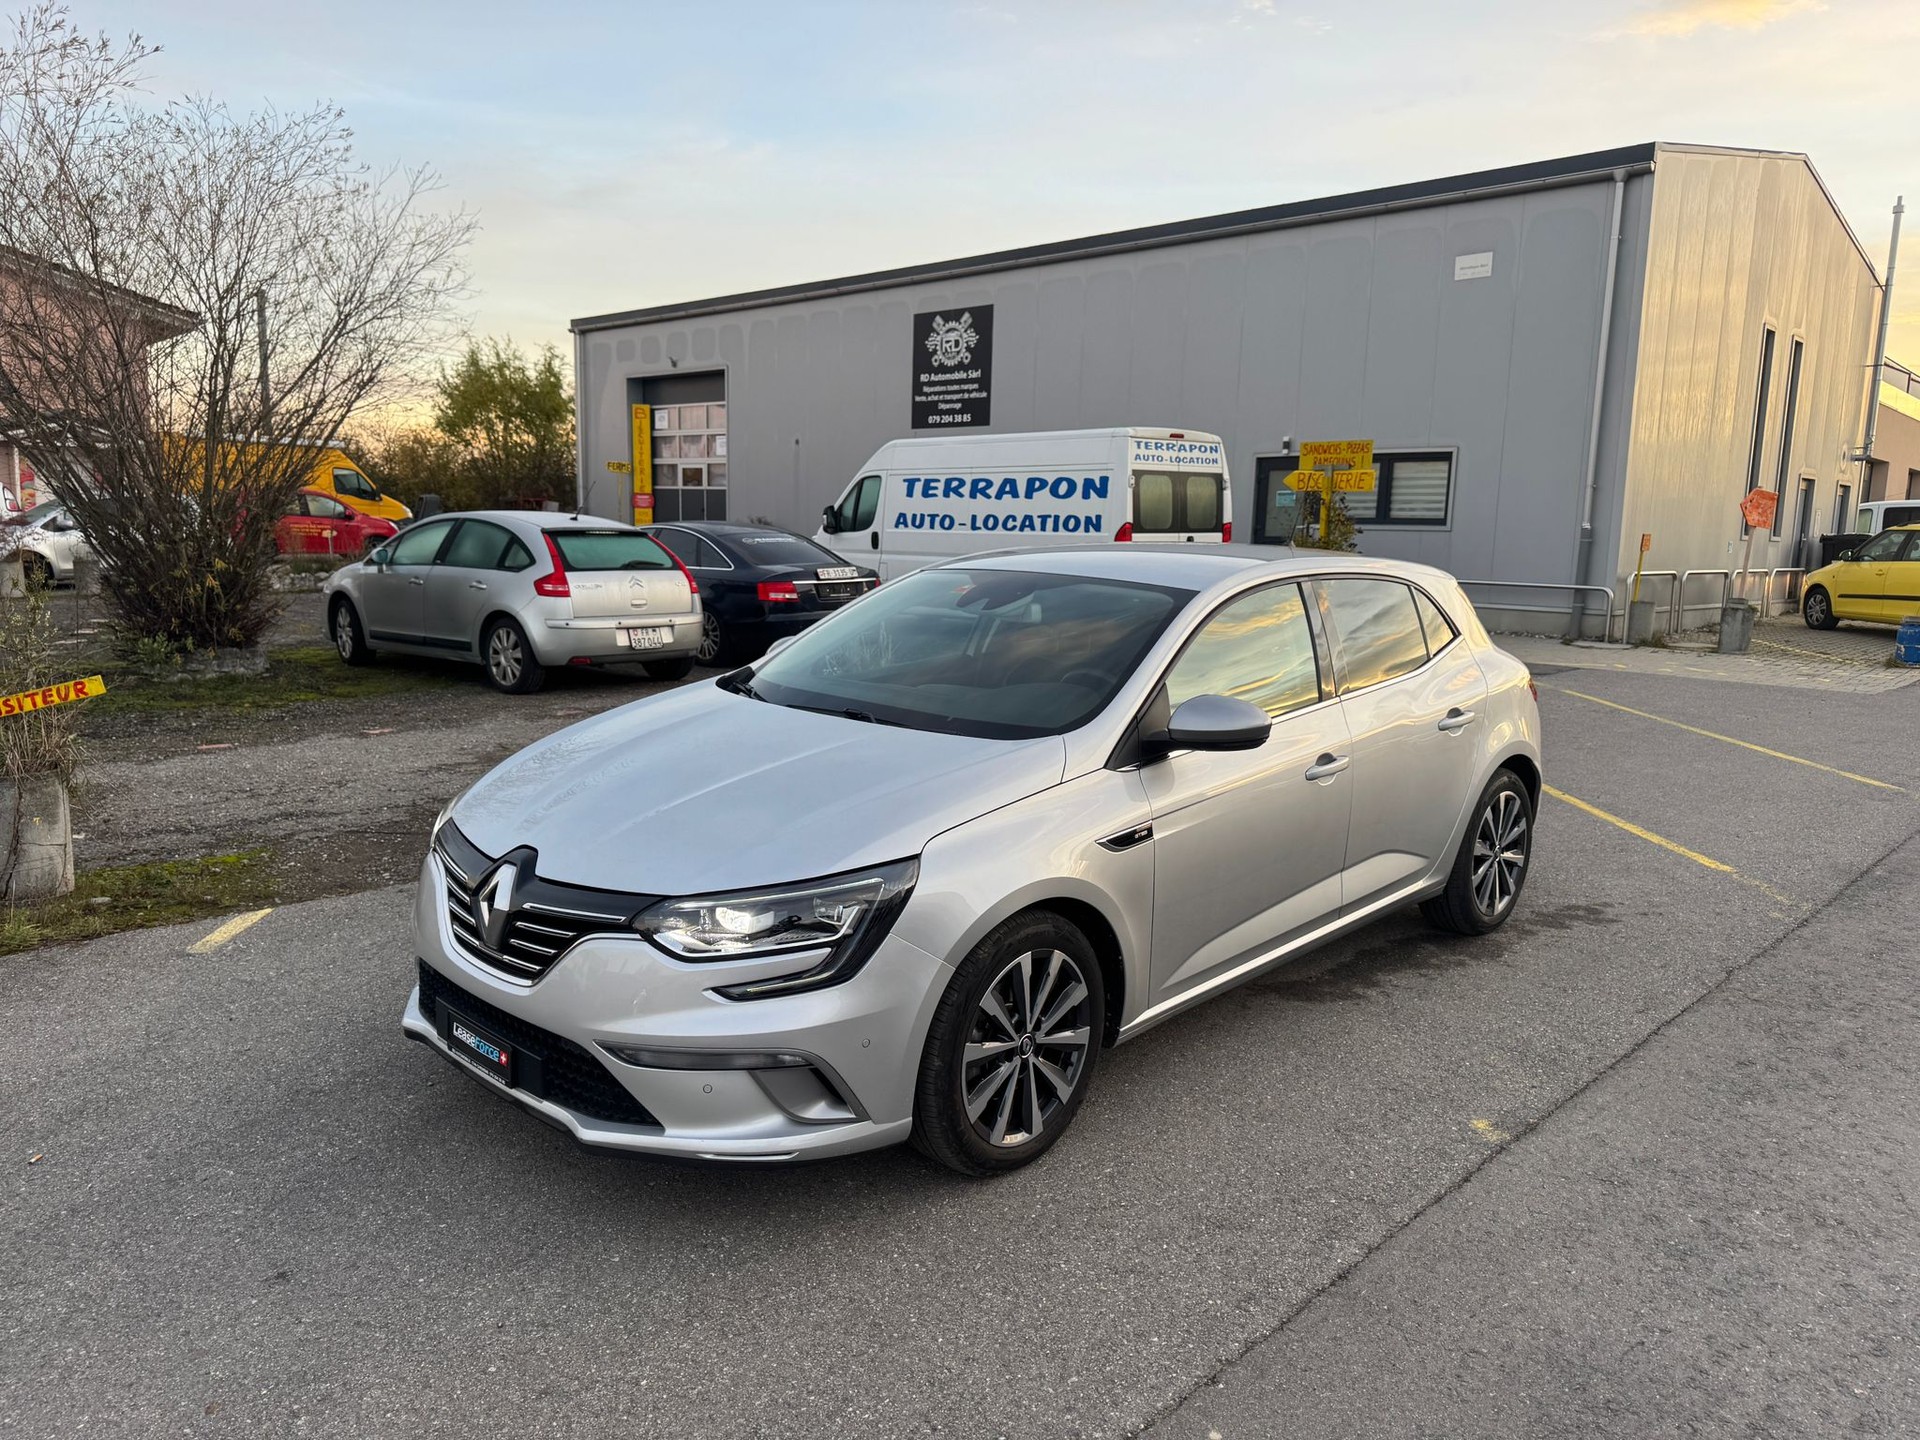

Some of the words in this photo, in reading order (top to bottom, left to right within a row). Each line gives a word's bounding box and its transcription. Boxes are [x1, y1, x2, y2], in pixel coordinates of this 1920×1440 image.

[943, 338, 962, 353] RD
[920, 373, 930, 382] RD
[930, 370, 967, 381] Automobile
[928, 414, 940, 424] 079
[941, 414, 953, 424] 204
[953, 413, 962, 423] 38
[962, 413, 971, 422] 85
[1134, 440, 1219, 454] TERRAPON
[1134, 453, 1218, 465] AUTO-LOCATION
[902, 475, 1109, 500] TERRAPON
[1297, 472, 1369, 491] BISCTERIE
[894, 512, 1103, 533] AUTO-LOCATION
[0, 681, 89, 716] SITEUR
[453, 1021, 500, 1061] LeaseForce
